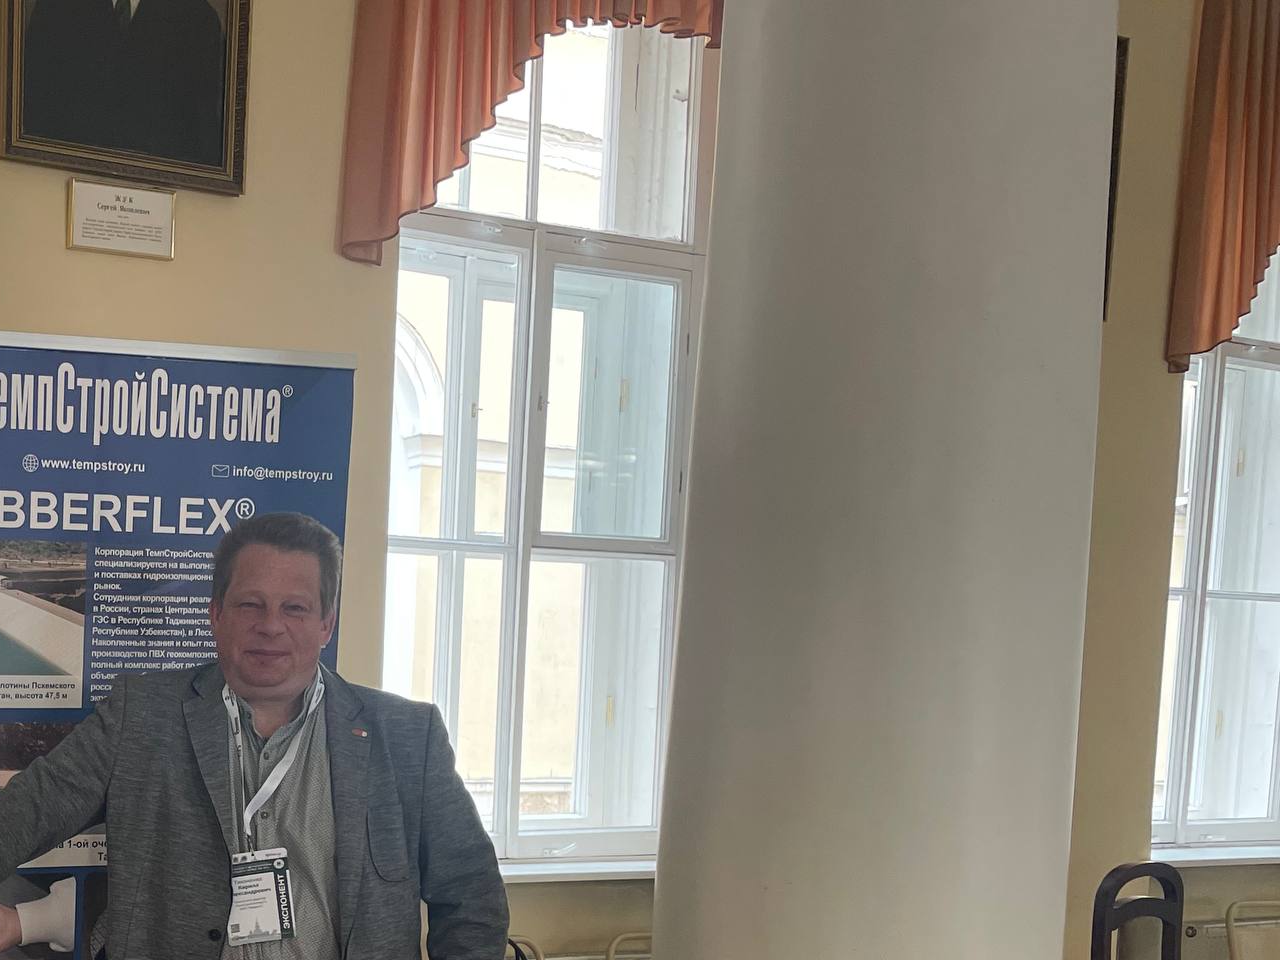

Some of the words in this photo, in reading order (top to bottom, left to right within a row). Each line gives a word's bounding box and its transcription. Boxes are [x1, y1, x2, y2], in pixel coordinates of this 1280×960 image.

[41, 459, 145, 474] www.tempstroy.ru
[233, 466, 333, 482] info@tempstroy.ru
[94, 547, 143, 558] Корпорация
[145, 548, 214, 559] ТемпСтройСистем
[94, 560, 167, 570] специализируется
[143, 573, 213, 581] гидроизоляционн
[93, 593, 140, 603] Сотрудники
[142, 595, 187, 604] корпорации
[100, 604, 131, 614] России,
[132, 606, 163, 614] странах
[93, 616, 109, 624] ГЭС
[118, 616, 163, 625] Республике
[165, 617, 211, 626] Таджикиста
[92, 627, 138, 637] Республике
[140, 628, 187, 638] Узбекистан),
[91, 638, 146, 647] Накопленные
[91, 650, 148, 659] производство
[149, 650, 165, 658] ПВХ
[166, 651, 218, 659] геокомпозито
[91, 660, 123, 669] полный
[162, 661, 184, 671] работ
[45, 692, 61, 701] 47,5
[67, 839, 89, 849] 1-ой
[276, 873, 291, 929] ЭКСПОНЕНТ
